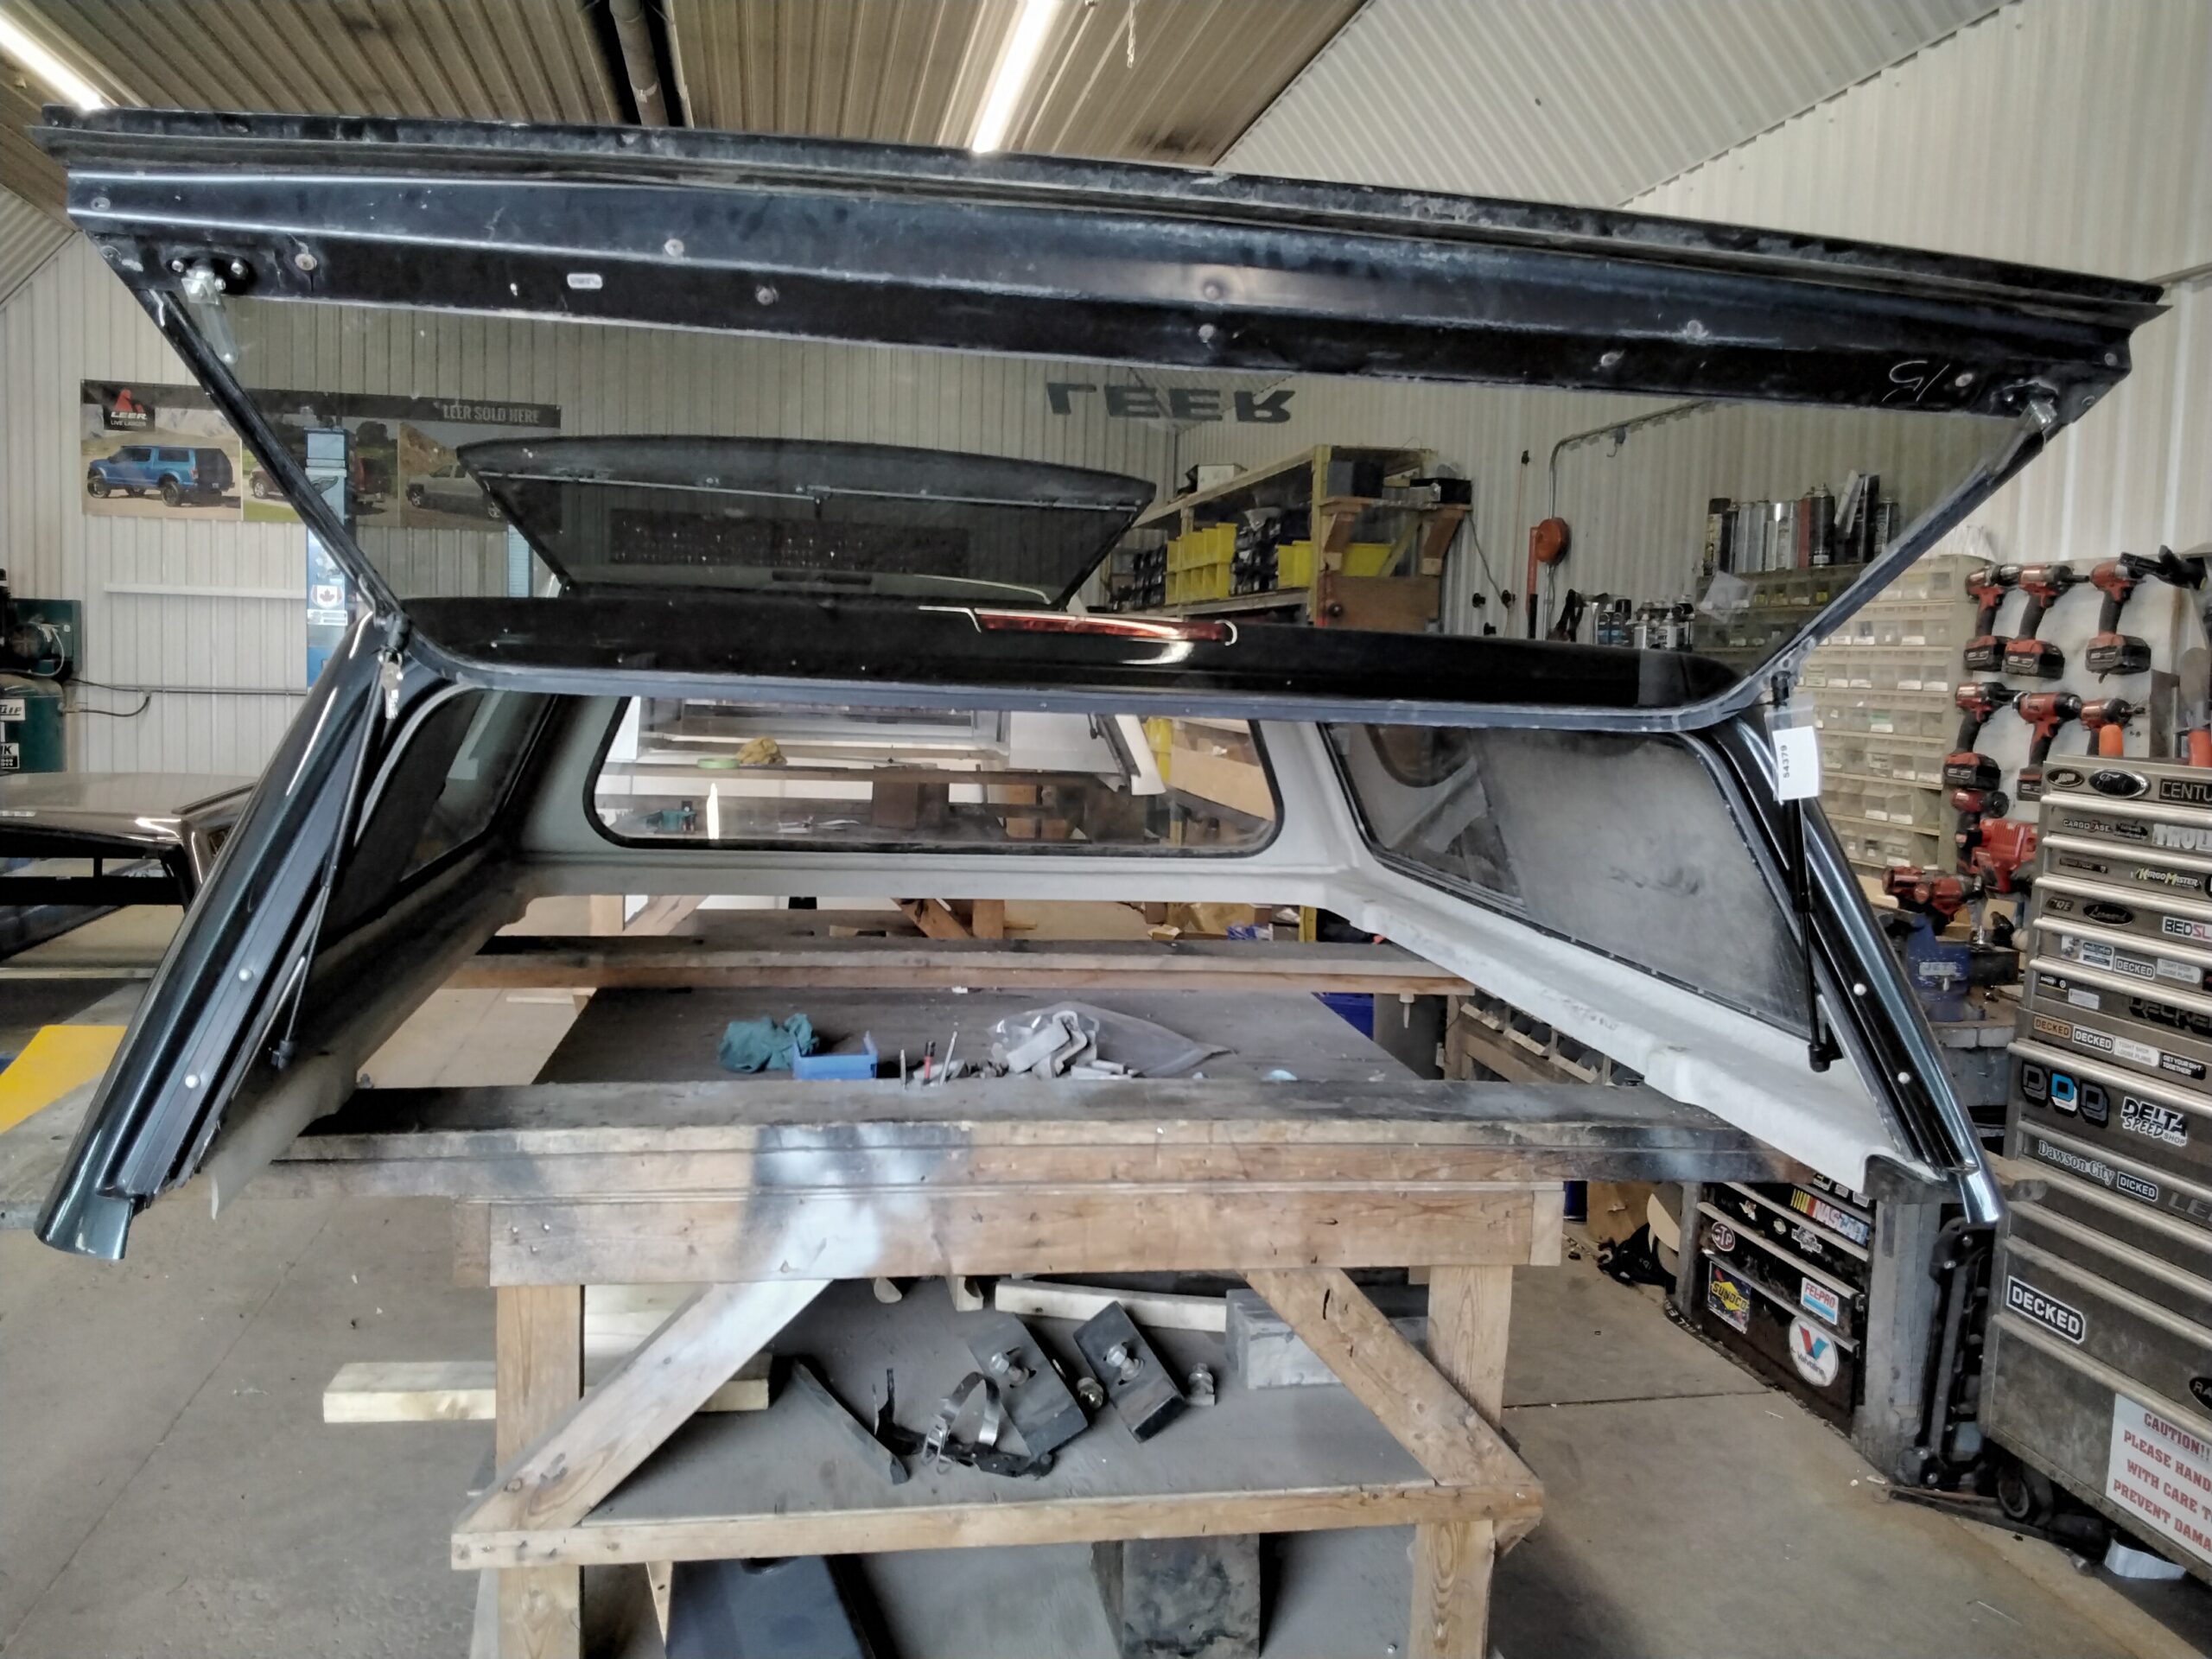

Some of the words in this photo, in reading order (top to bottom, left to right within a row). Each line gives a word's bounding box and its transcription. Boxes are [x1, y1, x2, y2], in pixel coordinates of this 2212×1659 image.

[111, 411, 147, 420] LEER
[443, 404, 471, 420] LEER
[474, 406, 506, 422] SOLD
[509, 407, 540, 423] HERE
[2117, 961, 2153, 976] DECKED
[2035, 1018, 2069, 1036] DECKED
[2075, 1030, 2112, 1049] DECKED
[2122, 1096, 2188, 1138] DELTA
[2124, 1114, 2164, 1139] SPEED
[2163, 1132, 2187, 1146] SHOP
[2038, 1140, 2088, 1173] Dawson
[2088, 1160, 2116, 1185] City
[2120, 1175, 2156, 1198] DICKED
[2168, 1192, 2212, 1223] LE
[1714, 1224, 1732, 1246] STP
[1711, 1282, 1748, 1309] SUNOCO
[2012, 1285, 2080, 1335] DECKED
[1797, 1352, 1827, 1382] Valvoline
[2144, 1412, 2210, 1462] CAUTION!!
[2124, 1429, 2171, 1468] PLEASE
[2175, 1460, 2212, 1493] HAND
[2113, 1478, 2171, 1524] PREVENT
[2127, 1459, 2159, 1491] WITH
[2163, 1482, 2198, 1514] CARE
[2202, 1505, 2212, 1522] T
